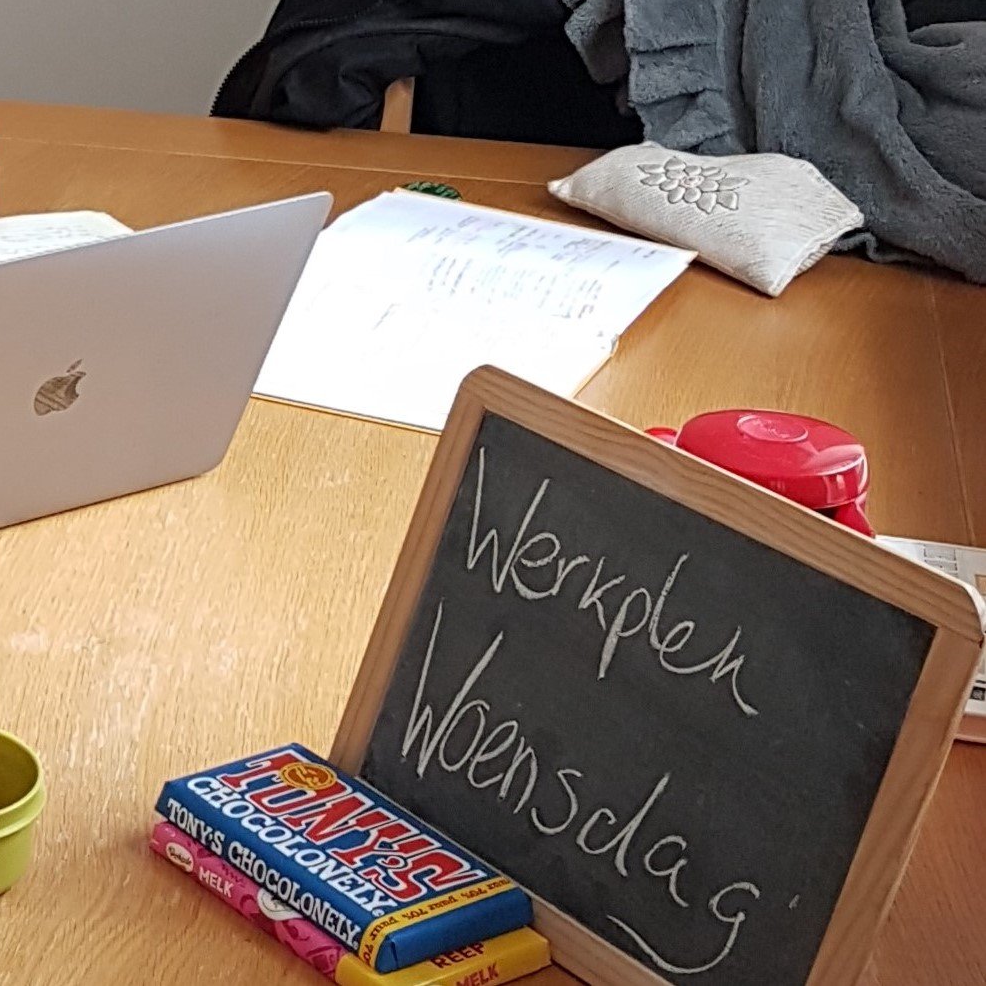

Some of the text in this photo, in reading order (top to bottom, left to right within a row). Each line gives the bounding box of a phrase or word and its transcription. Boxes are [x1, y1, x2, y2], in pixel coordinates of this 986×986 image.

[401, 597, 761, 974] Woensdag
[166, 798, 226, 856] TONY'S
[216, 749, 488, 902] TONY'S
[198, 866, 235, 898] MELK
[429, 942, 484, 969] REEP
[456, 962, 499, 986] MELK
